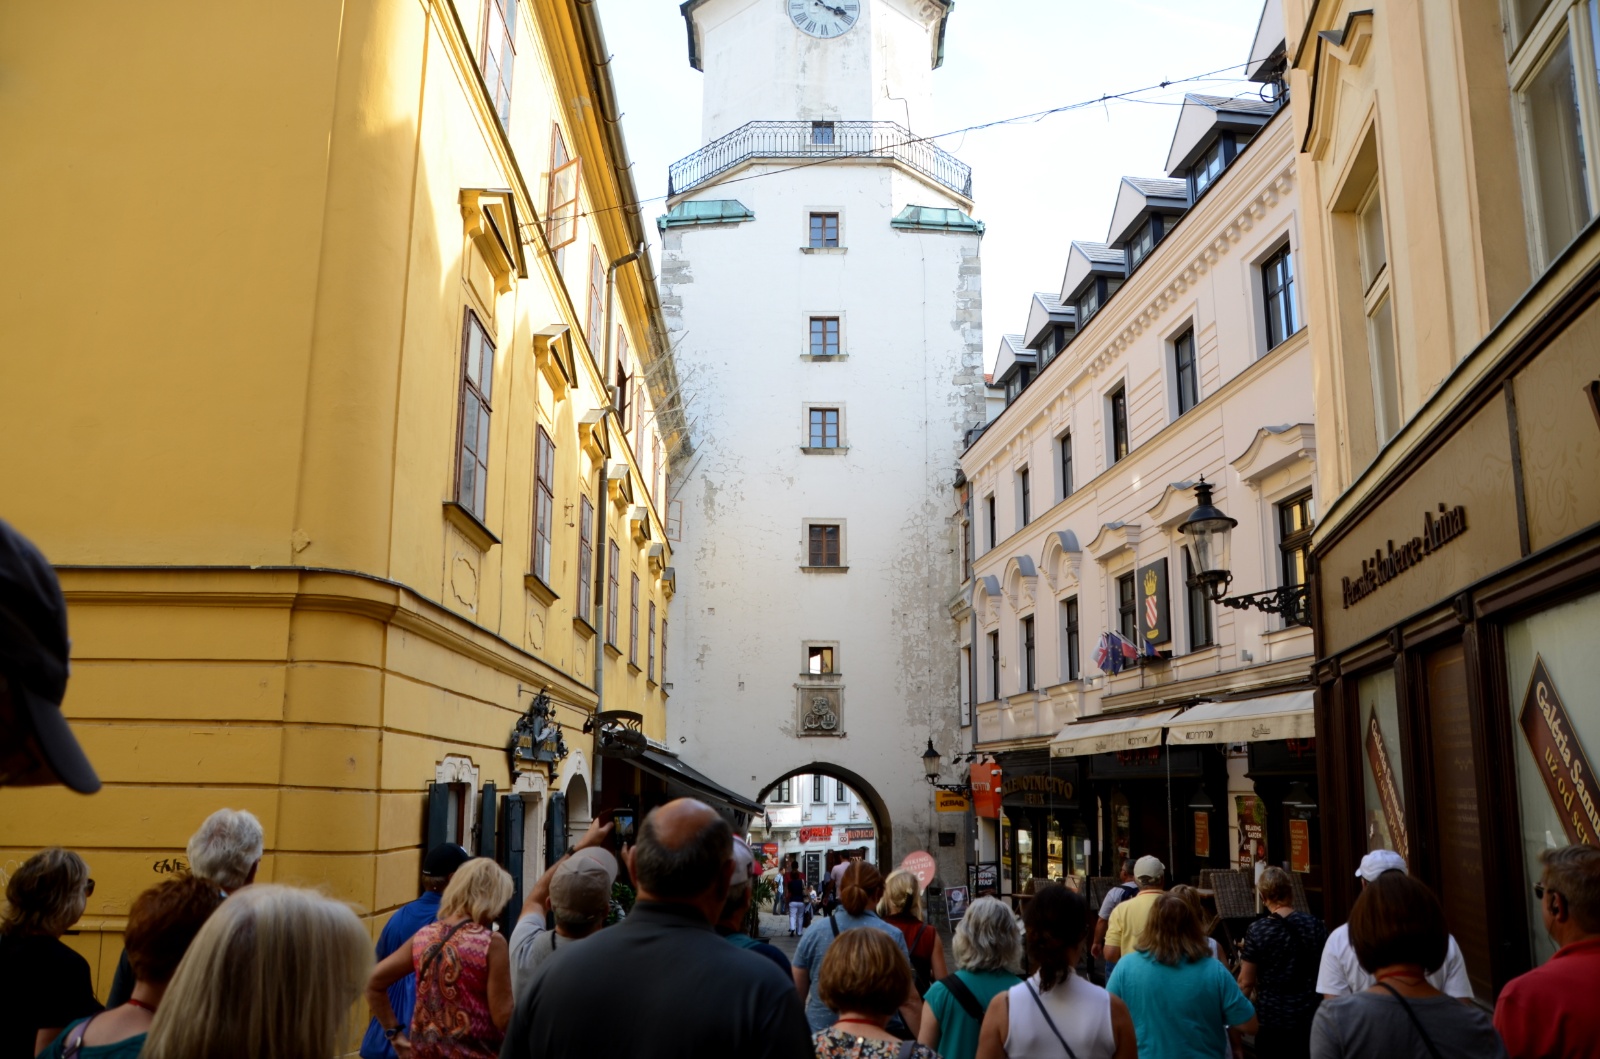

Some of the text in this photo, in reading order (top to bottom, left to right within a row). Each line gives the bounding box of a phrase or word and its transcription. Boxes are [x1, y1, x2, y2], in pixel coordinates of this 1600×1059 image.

[1375, 536, 1423, 587] koberce
[1423, 502, 1469, 556] Arina
[1536, 681, 1571, 768] Galéria
[940, 800, 964, 808] KEBAB
[1557, 777, 1575, 812] od
[904, 856, 929, 865] VIKING
[904, 861, 932, 871] RESTIGE
